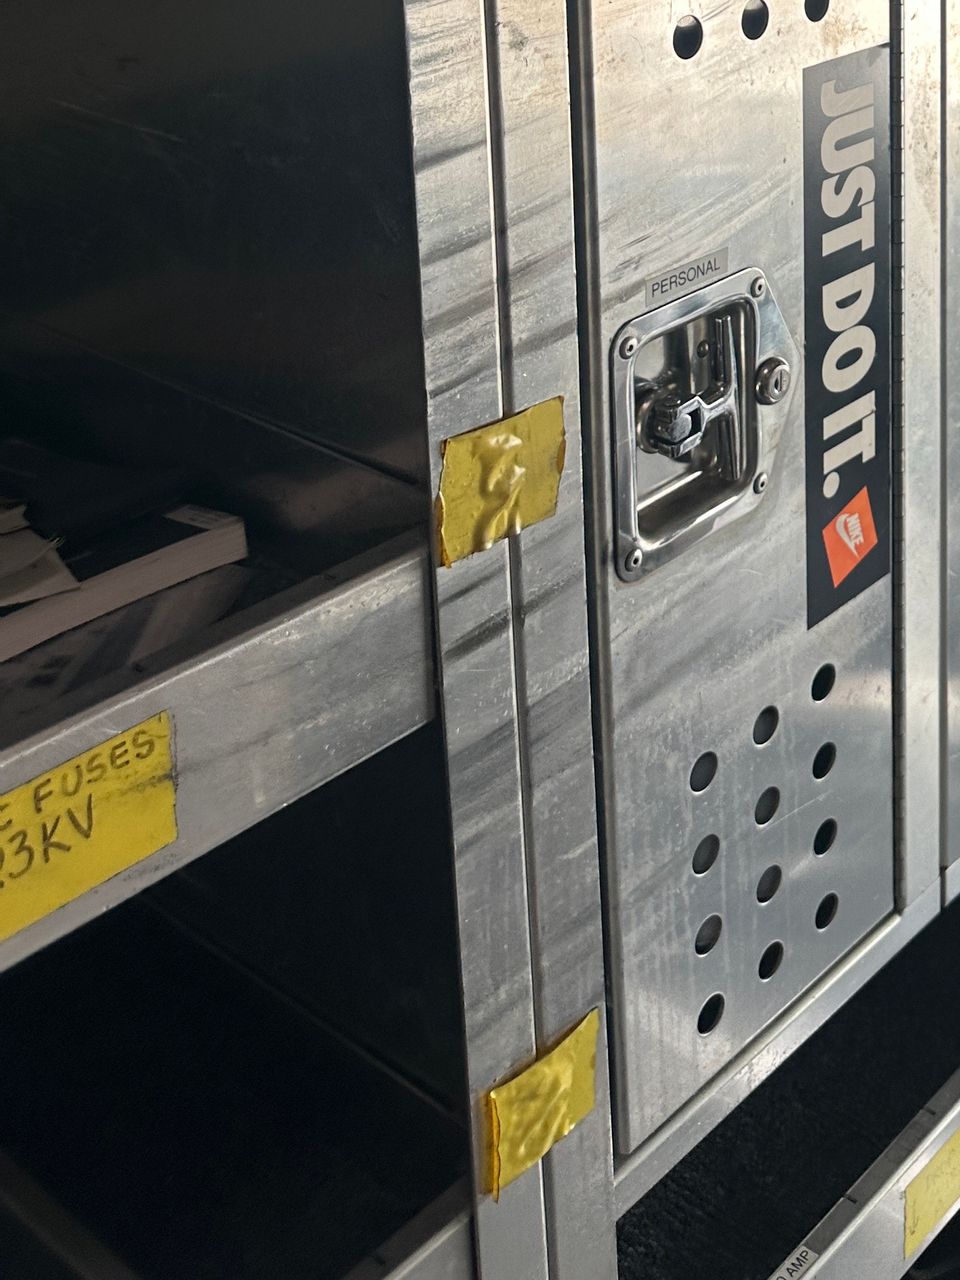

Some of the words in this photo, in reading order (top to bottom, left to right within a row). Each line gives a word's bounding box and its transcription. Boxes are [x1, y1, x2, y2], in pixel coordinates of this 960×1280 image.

[819, 78, 876, 259] JUST
[651, 257, 721, 298] PERSONAL
[821, 261, 877, 394] DO
[822, 389, 877, 499] IT.
[845, 512, 864, 545] NIKE
[33, 728, 156, 815] FUSES
[785, 1249, 810, 1278] AMP
